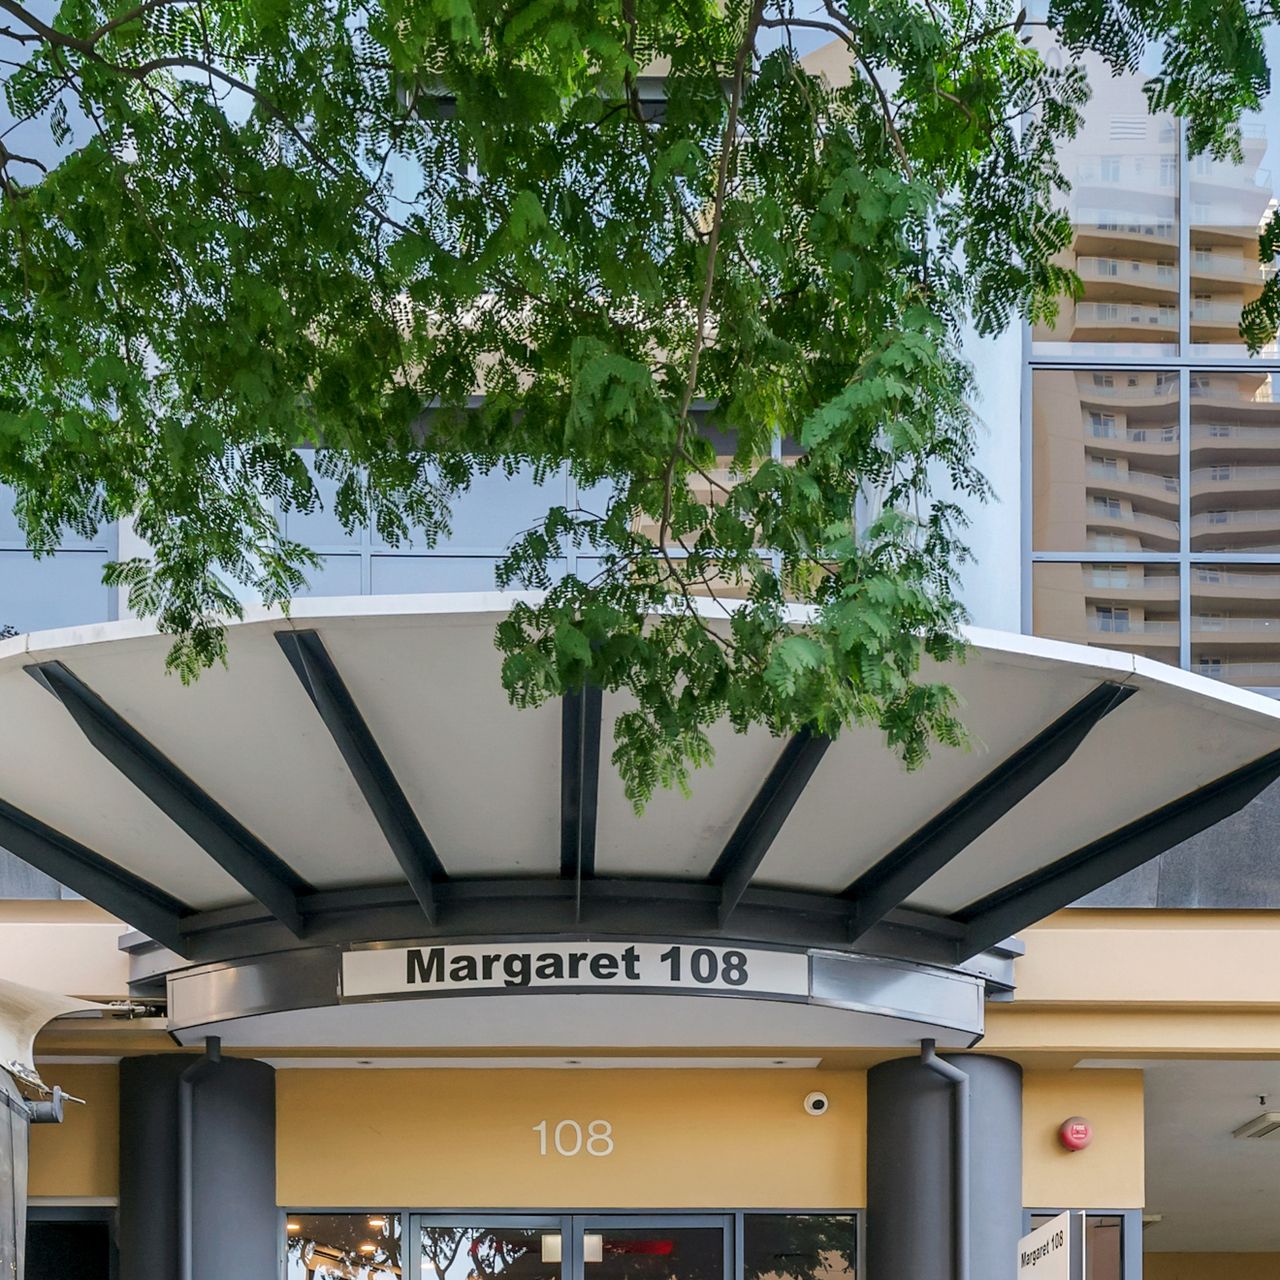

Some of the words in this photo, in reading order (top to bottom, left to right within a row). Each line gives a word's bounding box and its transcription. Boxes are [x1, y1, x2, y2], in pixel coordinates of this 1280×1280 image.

[405, 945, 641, 987] Margaret
[660, 945, 749, 986] 108
[532, 1119, 614, 1157] 108
[1021, 1239, 1049, 1269] Margaret
[1051, 1230, 1064, 1251] 108
